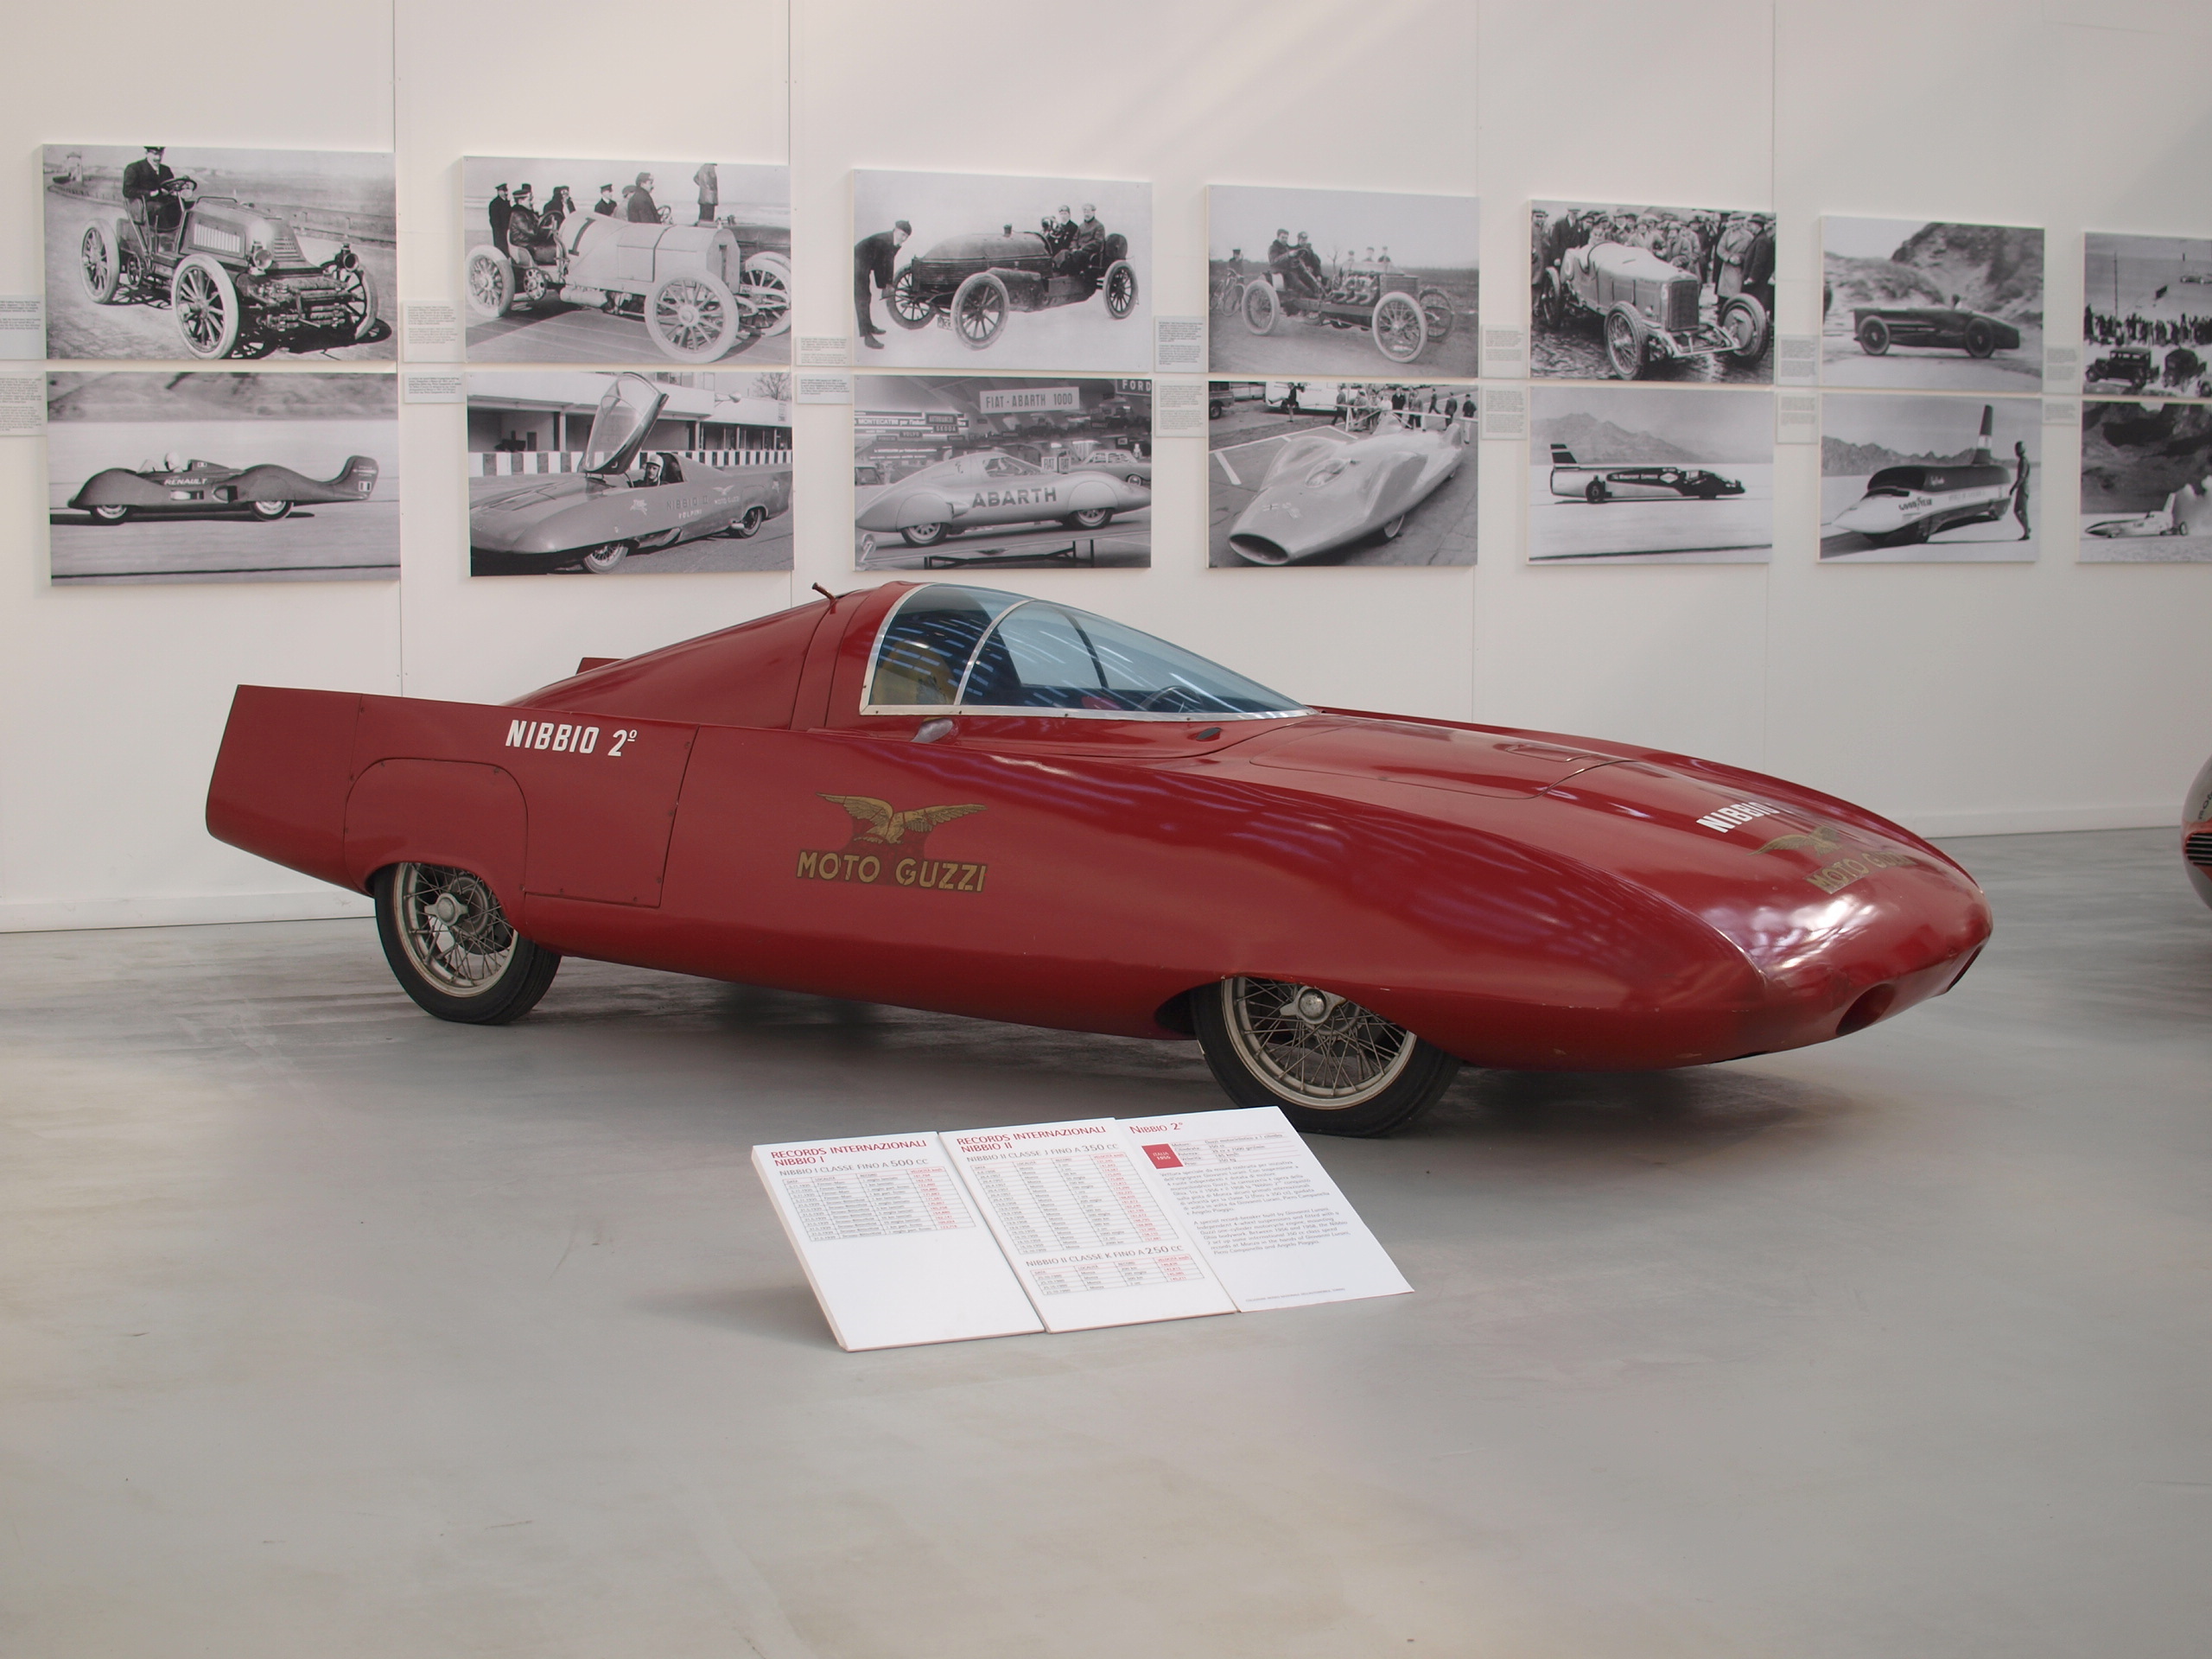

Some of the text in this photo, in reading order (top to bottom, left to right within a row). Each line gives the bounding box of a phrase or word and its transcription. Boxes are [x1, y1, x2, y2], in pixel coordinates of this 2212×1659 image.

[1122, 380, 1151, 391] FORD
[986, 392, 1073, 409] FIAT ABARTH 1000
[163, 477, 208, 486] RENAULT
[971, 487, 1057, 508] ABARTH
[505, 719, 600, 754] NIBBIO
[796, 851, 987, 892] MOTO GUZZI
[1806, 857, 1870, 891] MOTO
[957, 1125, 1107, 1145] RECORDS INTERNAZIONALI
[771, 1139, 927, 1159] RECORDS INTERNAZIONALI
[961, 1143, 1004, 1154] NIBBIO
[966, 1154, 998, 1162] NIBBIO
[1007, 1150, 1042, 1159] CLASSE
[1081, 1143, 1104, 1153] 350
[774, 1156, 817, 1166] NIBBIO
[779, 1167, 812, 1176] NIBBIO
[820, 1164, 855, 1173] CLASSE
[1026, 1258, 1059, 1267] NIBBIO
[1069, 1254, 1104, 1262] CLASSE
[1145, 1246, 1169, 1255] 250
